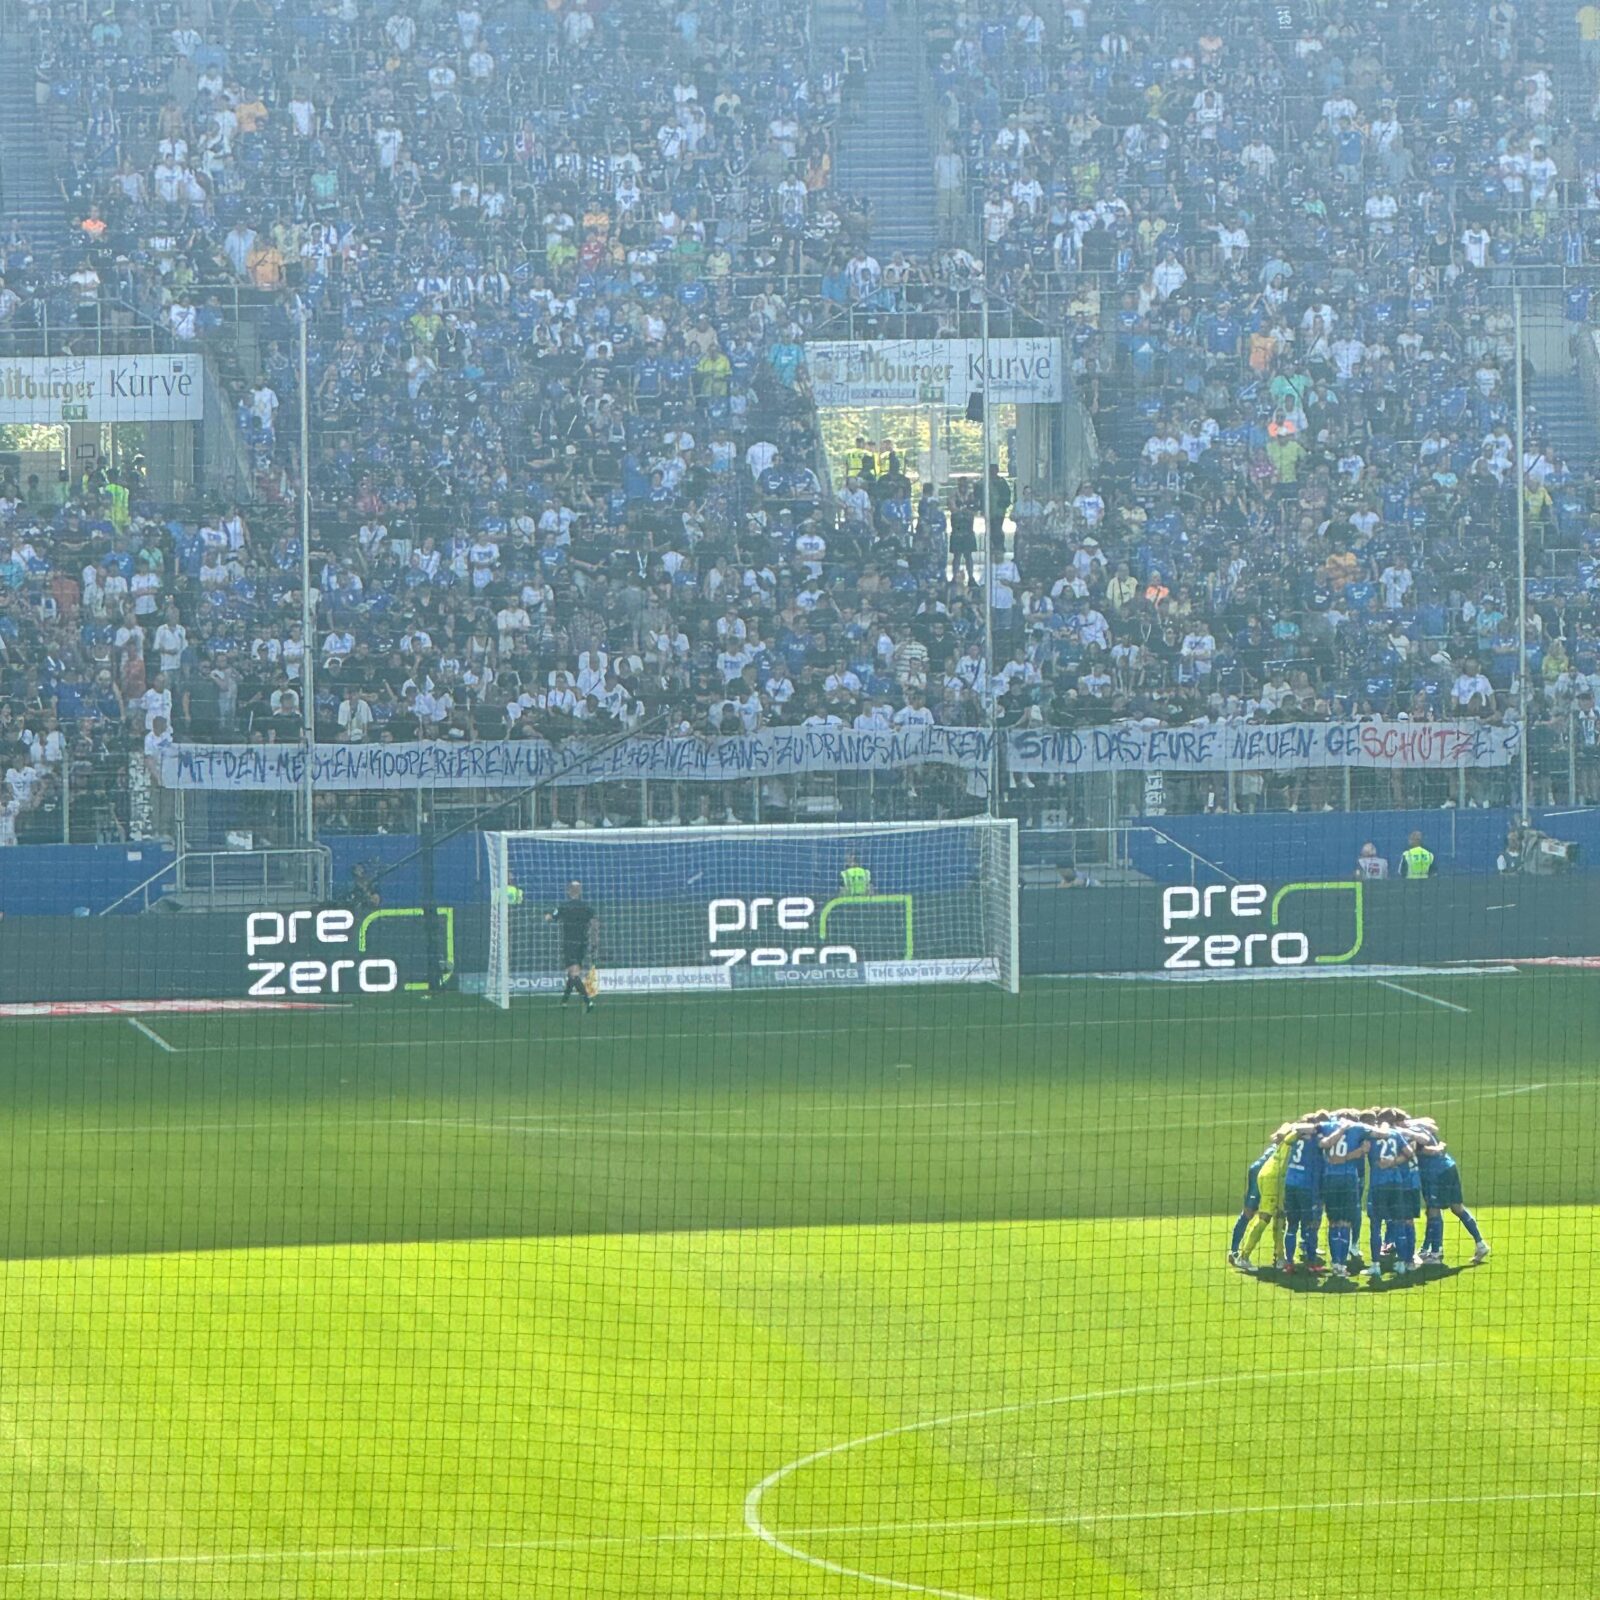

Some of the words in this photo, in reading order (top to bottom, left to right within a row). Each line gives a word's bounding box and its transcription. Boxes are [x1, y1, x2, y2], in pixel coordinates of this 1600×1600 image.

[0, 367, 95, 404] itburger
[110, 368, 192, 397] Kurve
[969, 353, 1051, 381] Kurve
[223, 747, 266, 782] DEN
[370, 745, 522, 779] KOOPERIEREN
[719, 738, 769, 768] FANS
[774, 735, 804, 764] ZU
[1093, 730, 1142, 762] DAS
[1149, 730, 1217, 763] EURE
[1232, 727, 1313, 760] NEUEN
[708, 896, 815, 943] pre
[1163, 883, 1267, 930] pre
[247, 909, 354, 956] pre
[1164, 932, 1309, 969] zero
[248, 958, 398, 996] zero
[774, 968, 859, 981] sovanta
[871, 968, 894, 978] THE
[896, 967, 917, 978] SAP
[1292, 1139, 1305, 1164] 3
